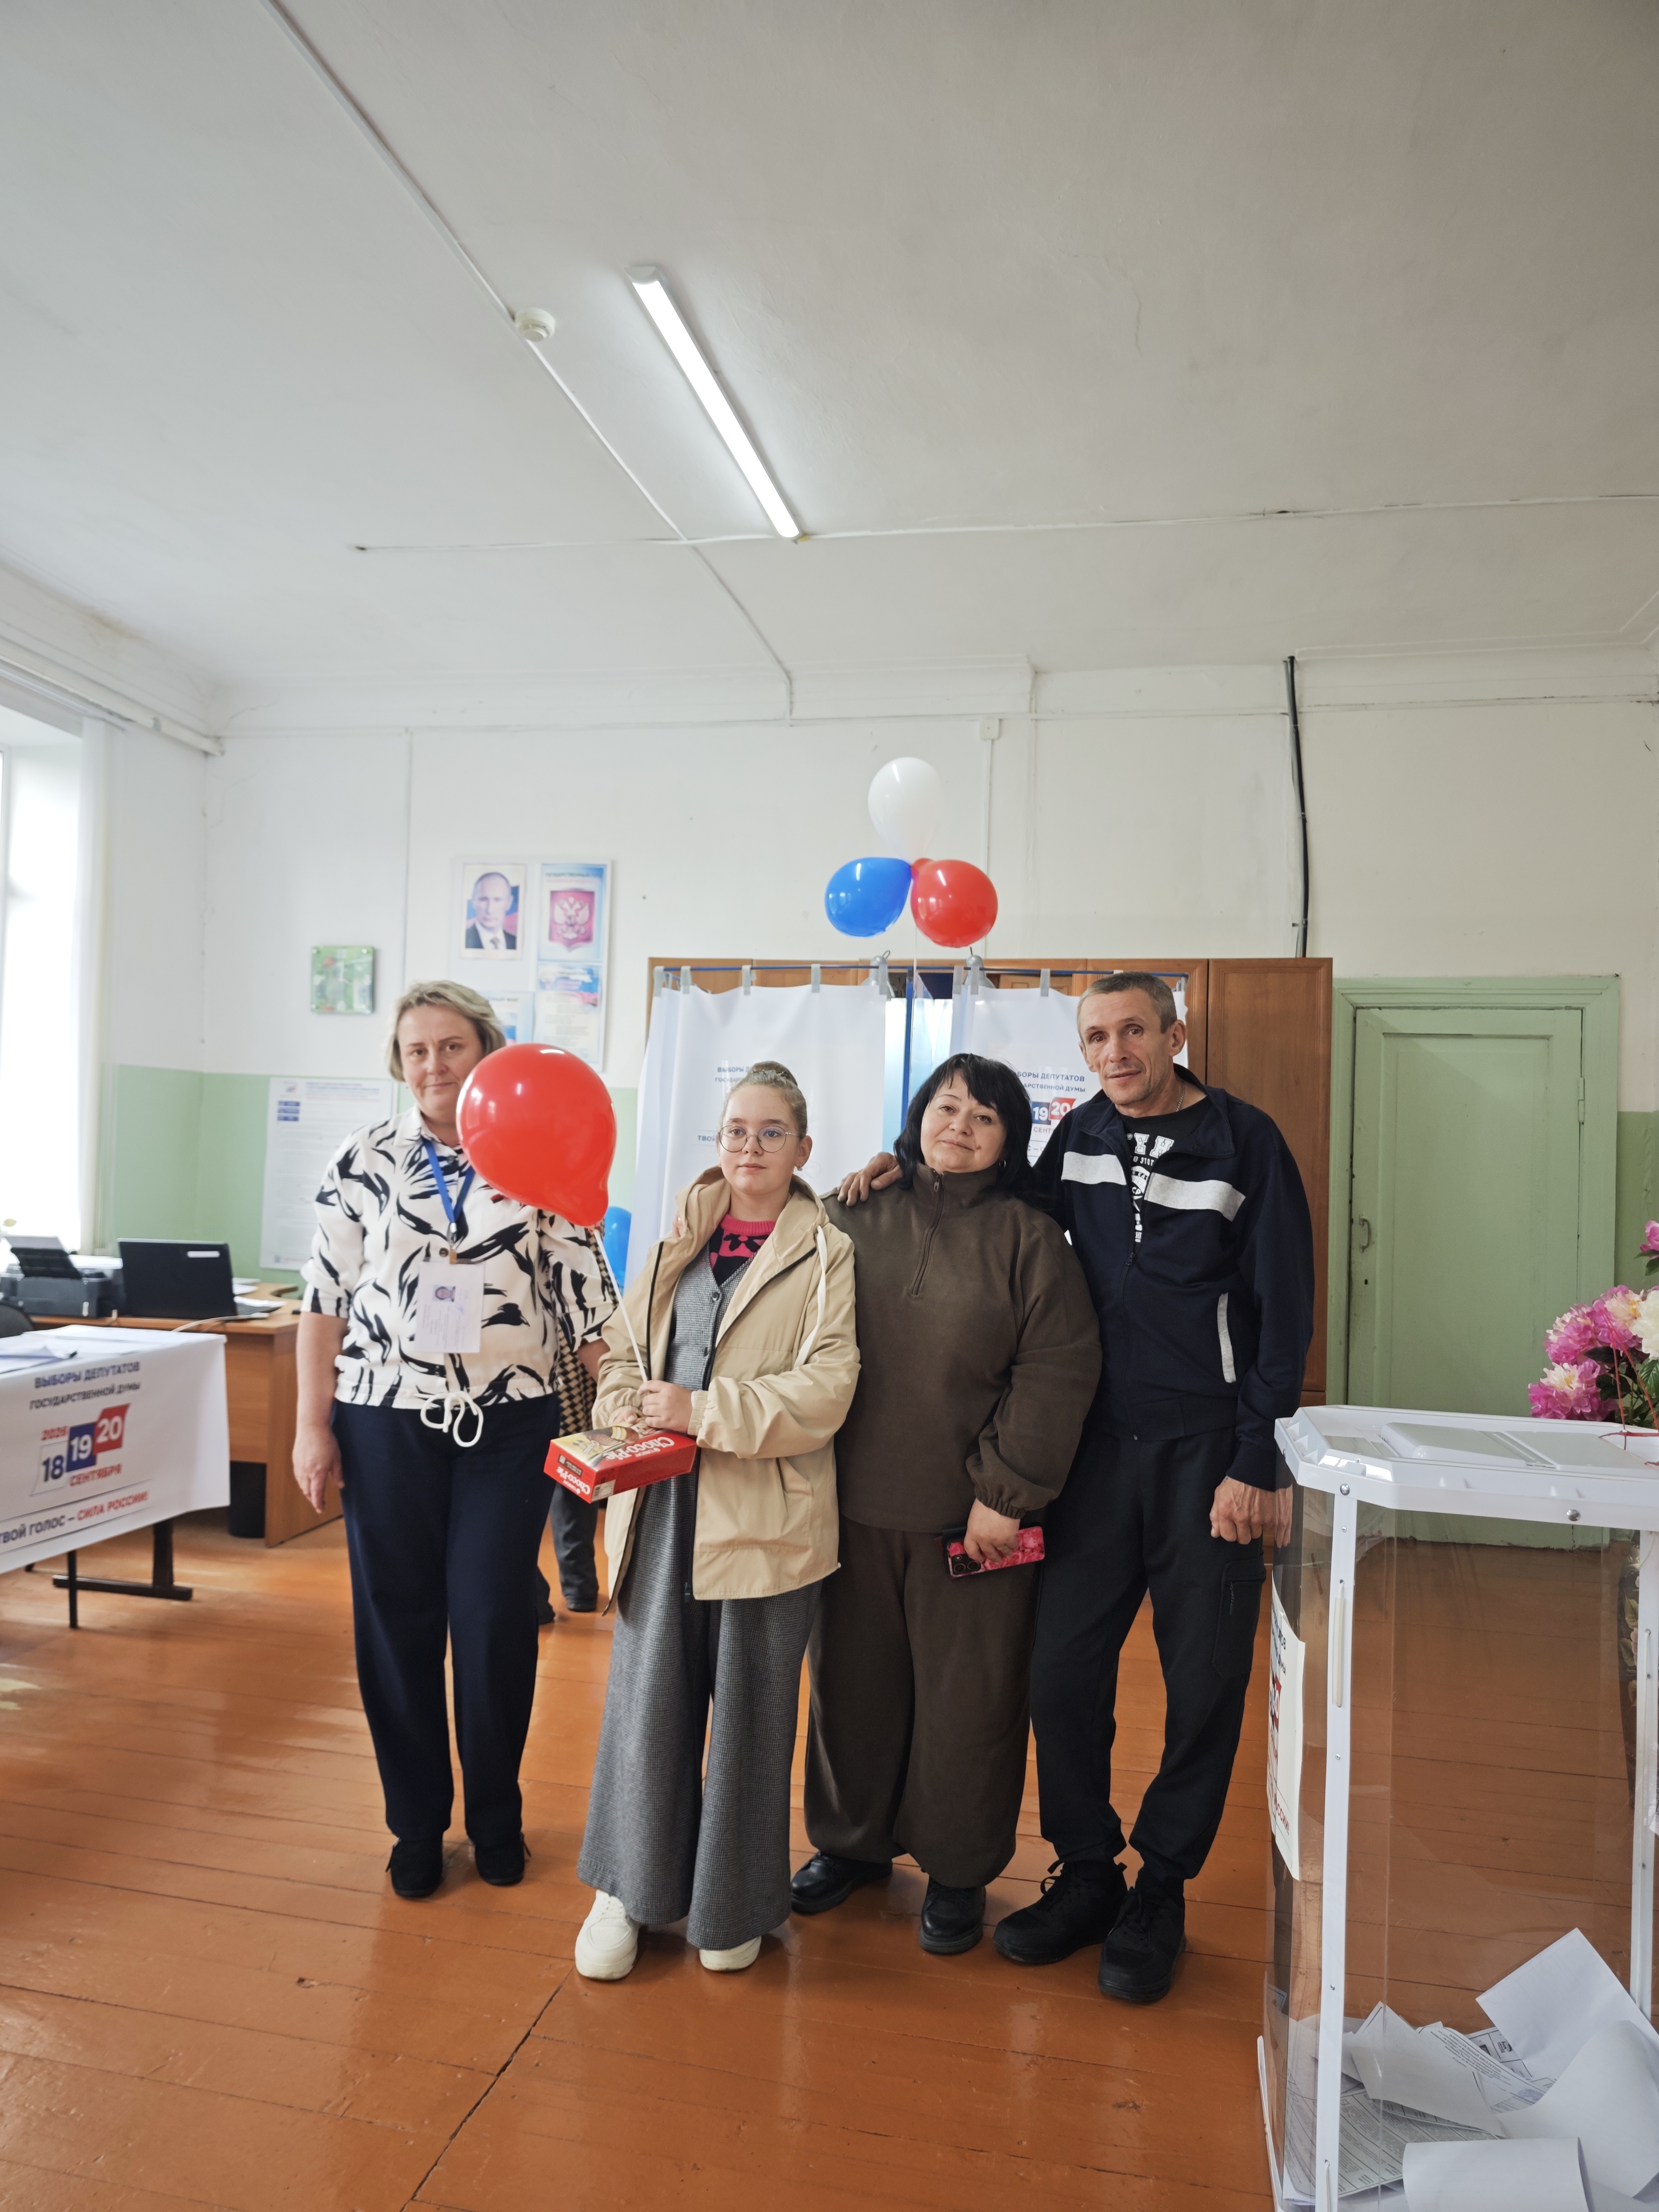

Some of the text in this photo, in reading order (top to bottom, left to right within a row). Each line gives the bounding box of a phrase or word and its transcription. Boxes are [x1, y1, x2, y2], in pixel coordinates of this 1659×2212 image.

[1023, 1083, 1064, 1091] АРСТВЕННОЙ
[1041, 1073, 1085, 1082] ДЕПУТАТОВ
[1033, 1107, 1048, 1121] 19
[1051, 1101, 1071, 1117] 20
[35, 1361, 140, 1388] ВЫБОРЫ ДЕПУТАТОВ
[29, 1381, 141, 1410] ГОСУДАРСТВЕННОЙ ДУМЫ
[97, 1415, 123, 1444] 20
[71, 1434, 93, 1462] 19
[42, 1454, 65, 1482] 18
[69, 1463, 122, 1487] СЕНТЯБРЯ
[29, 1515, 65, 1536] ГОЛОС
[77, 1503, 104, 1521] СИЛА
[107, 1490, 150, 1512] РОССИИ!
